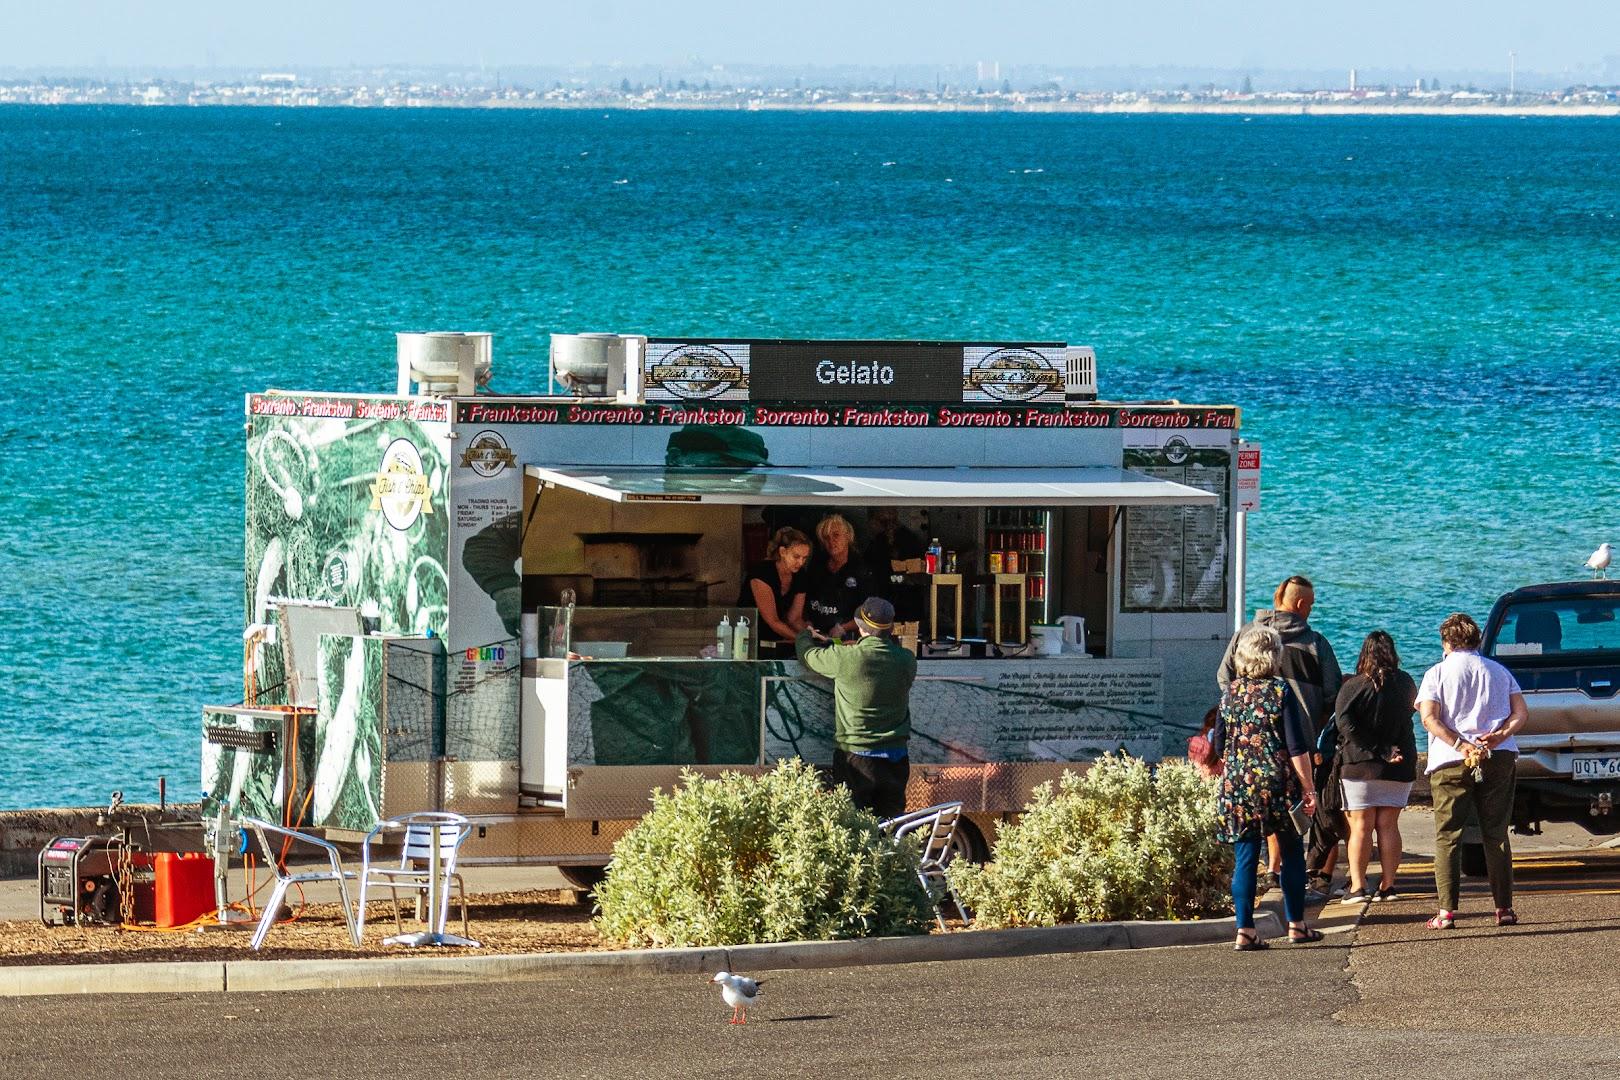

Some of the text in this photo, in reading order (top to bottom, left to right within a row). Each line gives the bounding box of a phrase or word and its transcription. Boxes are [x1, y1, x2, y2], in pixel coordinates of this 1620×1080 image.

[816, 360, 894, 385] Gelato
[253, 395, 296, 415] Sorrento
[302, 397, 353, 418] Frankston
[357, 399, 400, 420] Sorrento
[470, 405, 558, 423] Frankston
[567, 406, 645, 424] Sorrento
[659, 406, 746, 425] Frankston
[755, 408, 830, 426] Sorrento
[843, 408, 930, 427] Frankston
[937, 409, 1012, 427] Sorrento
[1024, 410, 1109, 427] Frankston
[1119, 410, 1190, 428] Sorrento
[1238, 452, 1258, 460] PERMIT
[1240, 460, 1256, 468] ZONE
[378, 478, 396, 494] Fish
[405, 479, 425, 496] Chips
[466, 647, 505, 661] GELATO
[1575, 761, 1598, 774] UQI
